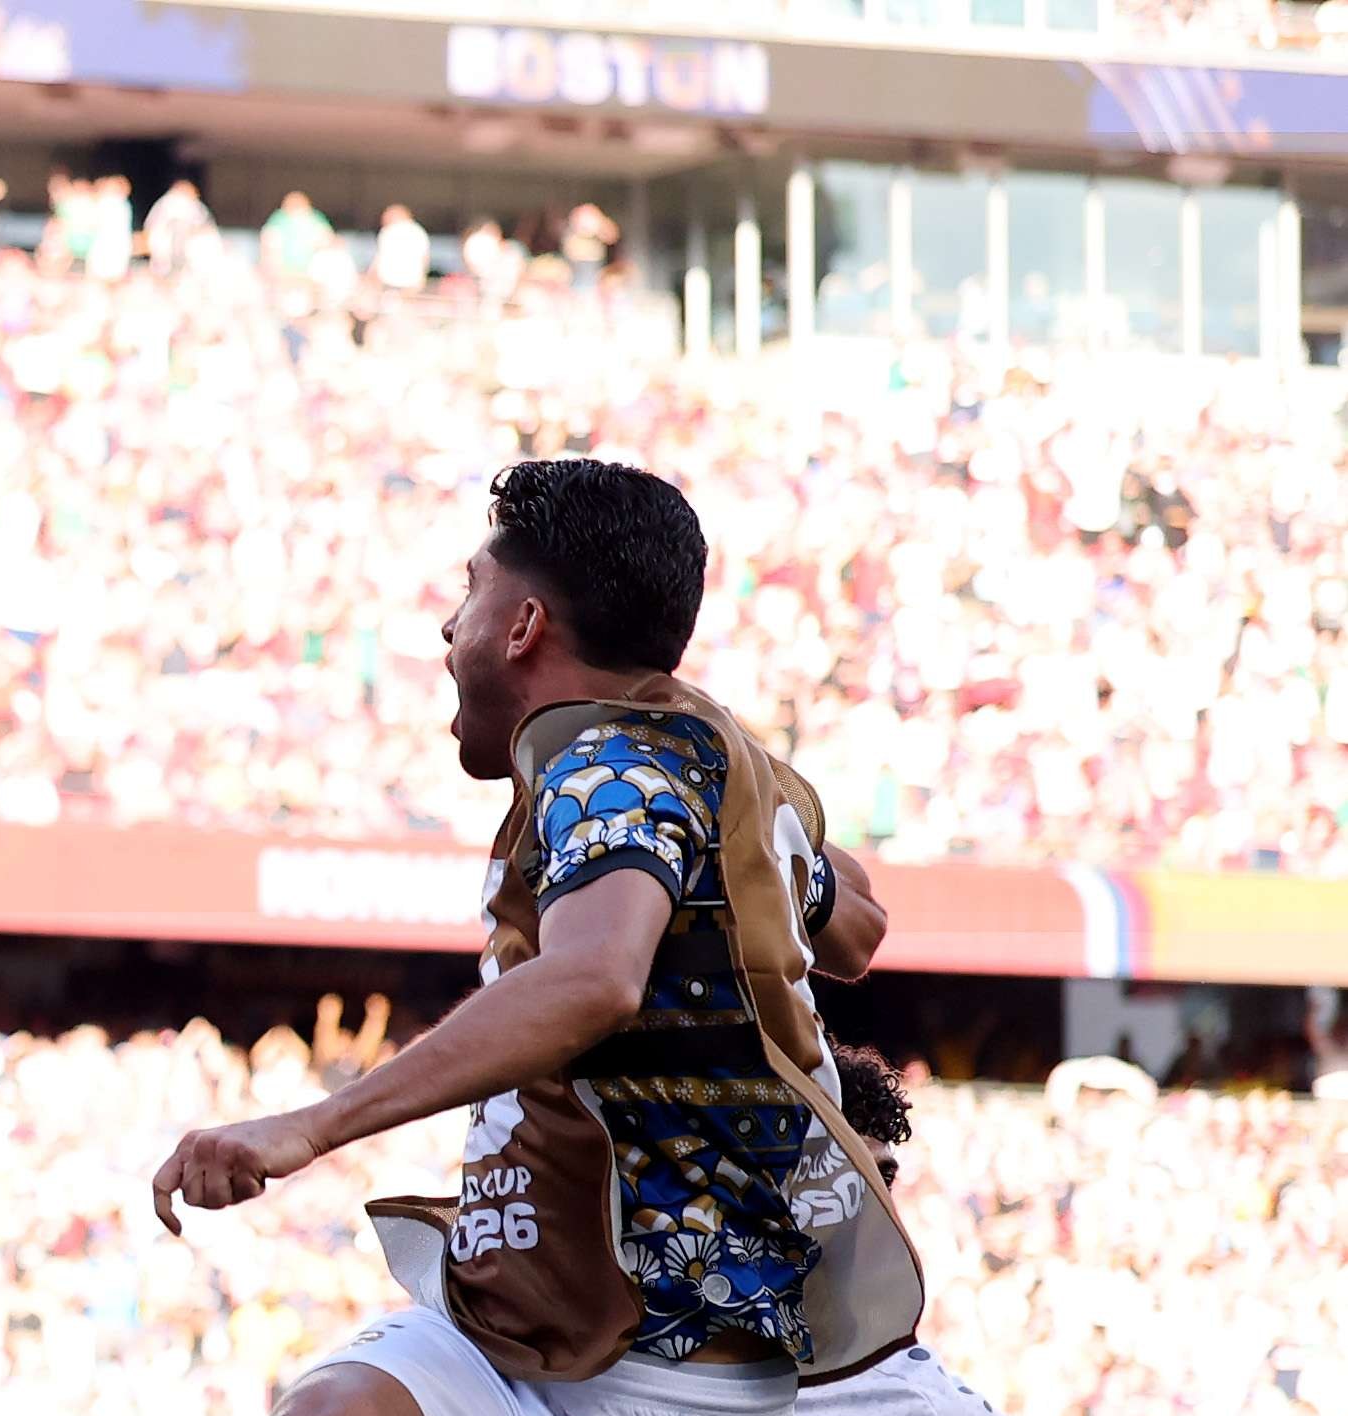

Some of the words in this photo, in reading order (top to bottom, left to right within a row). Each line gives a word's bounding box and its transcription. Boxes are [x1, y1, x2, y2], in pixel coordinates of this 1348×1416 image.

[447, 25, 768, 115] BOSTON
[481, 1166, 532, 1200] CUP
[451, 1202, 539, 1263] 026
